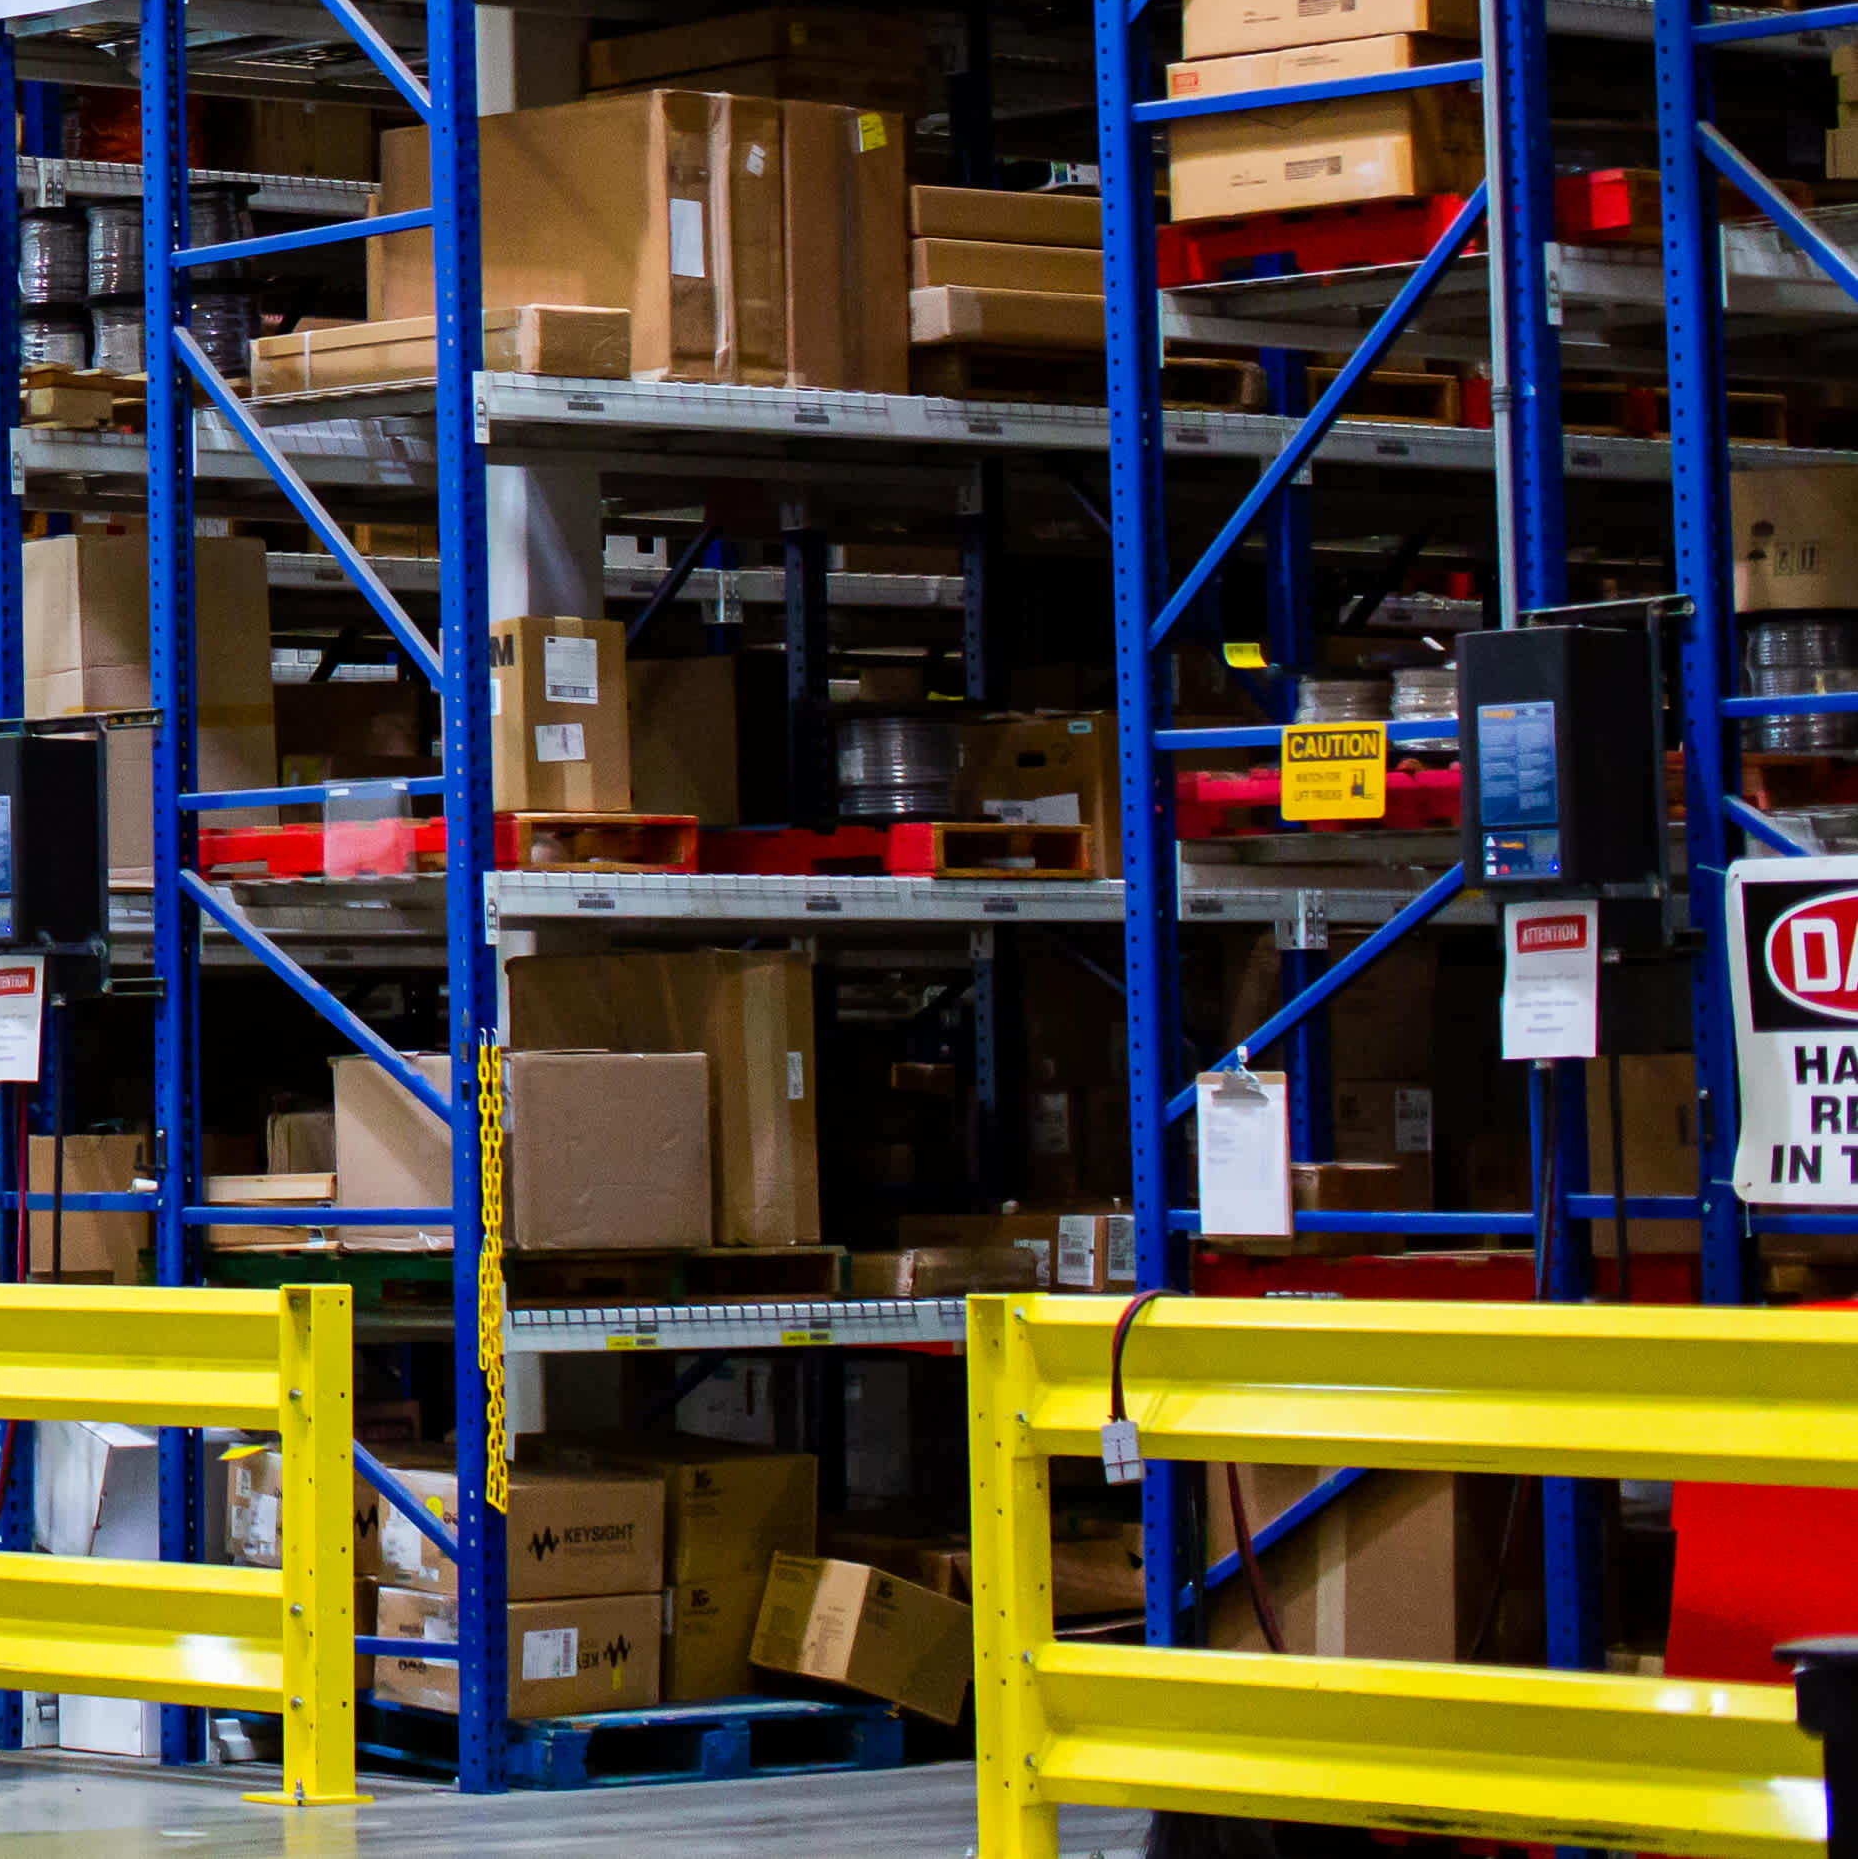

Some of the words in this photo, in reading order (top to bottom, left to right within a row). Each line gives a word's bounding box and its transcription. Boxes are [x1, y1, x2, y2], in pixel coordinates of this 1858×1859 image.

[491, 634, 515, 668] M
[1289, 732, 1379, 760] CAUTION
[1522, 923, 1579, 945] ATTENTION
[1770, 1144, 1823, 1184] IN
[564, 1523, 635, 1543] KEYSIGHT
